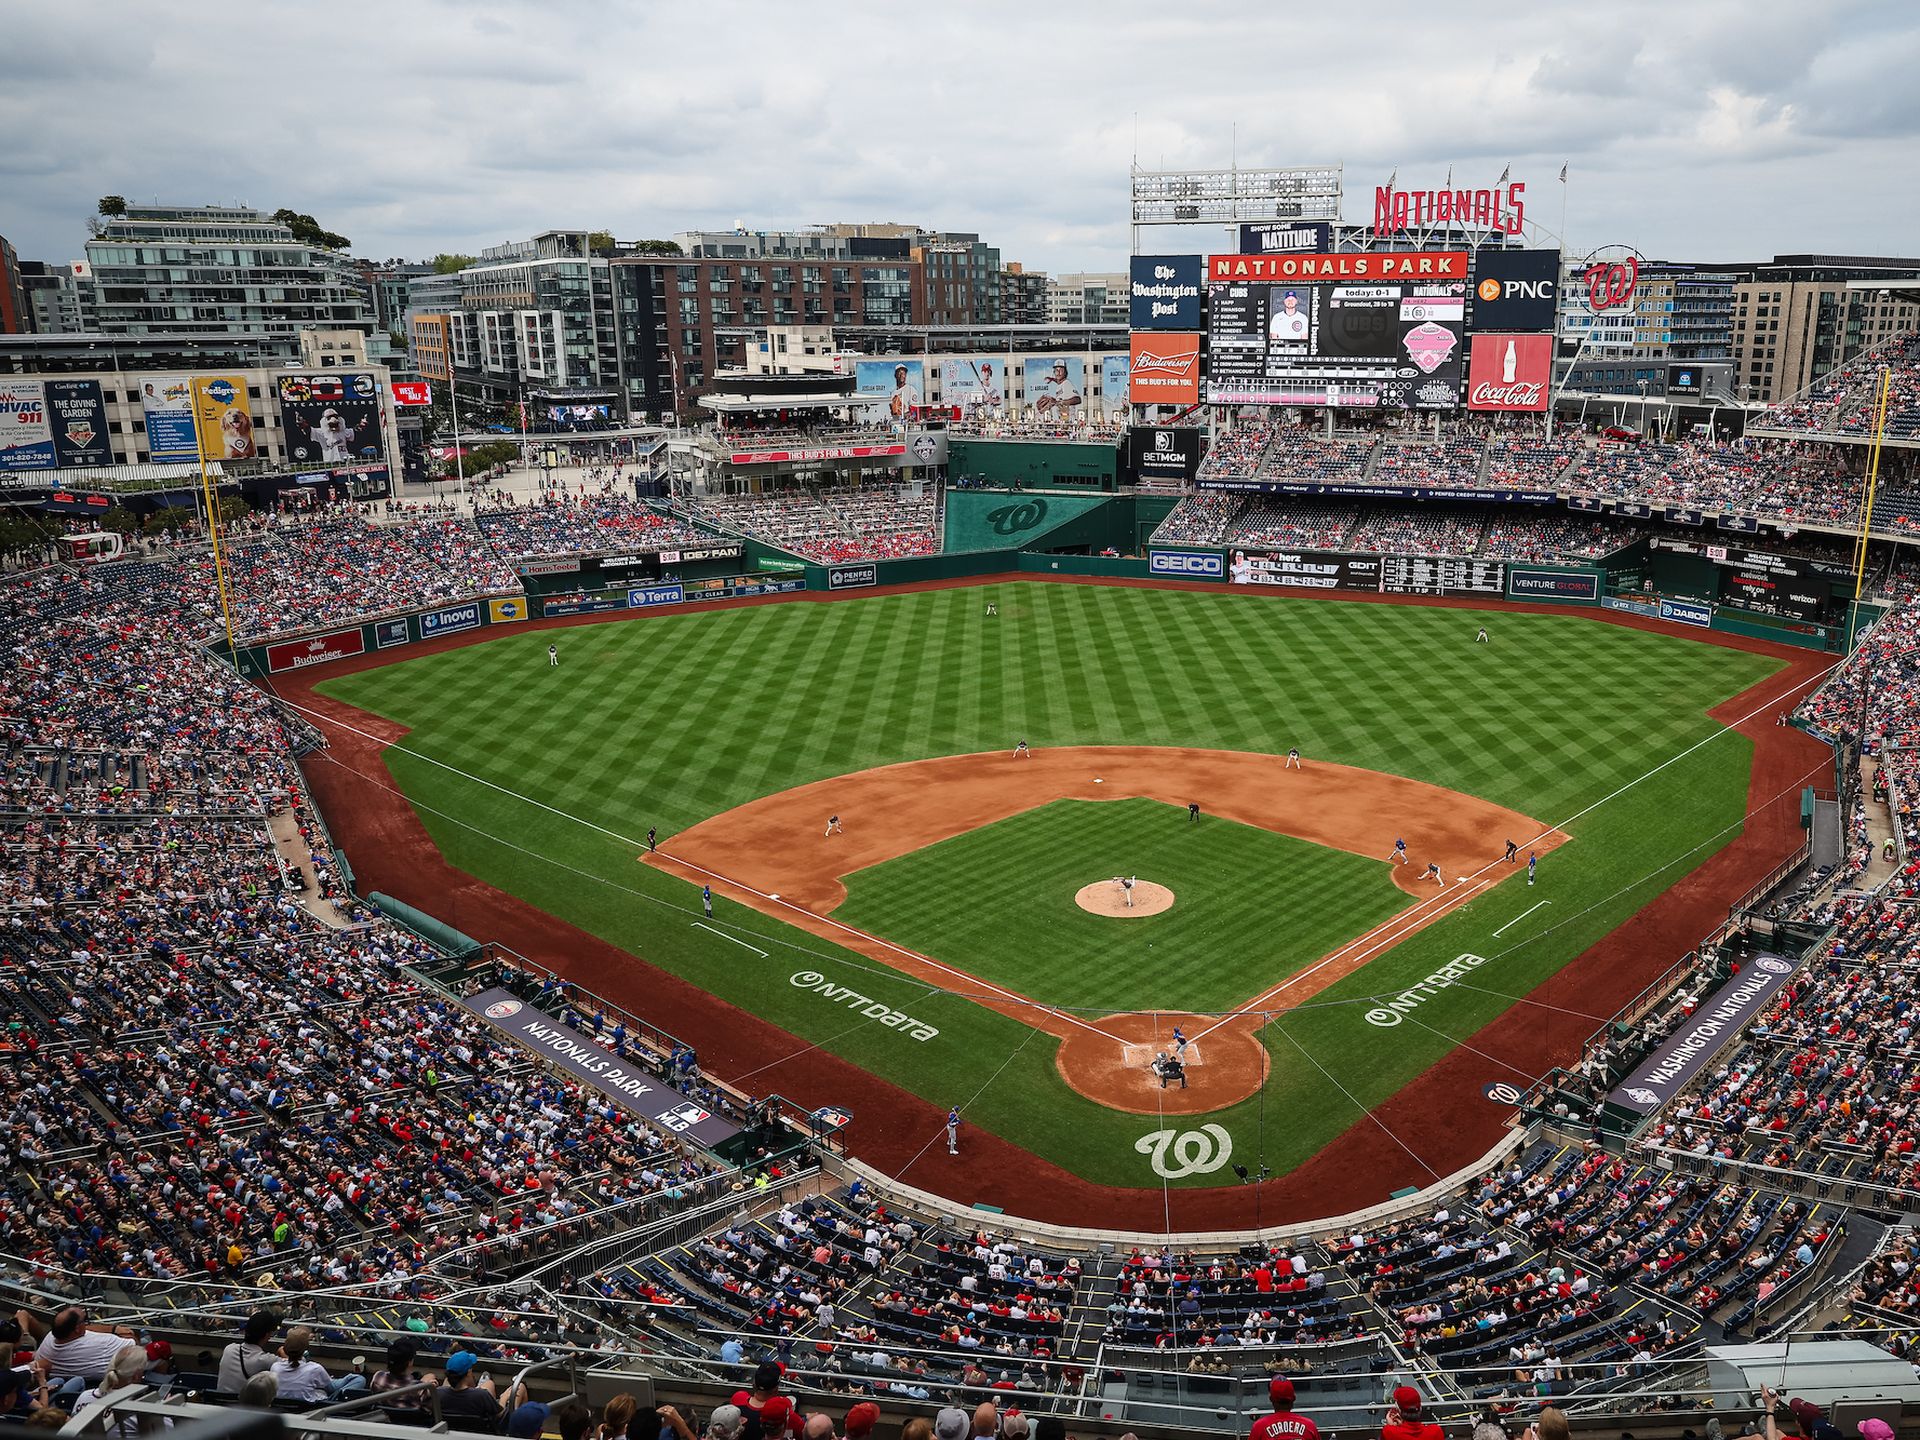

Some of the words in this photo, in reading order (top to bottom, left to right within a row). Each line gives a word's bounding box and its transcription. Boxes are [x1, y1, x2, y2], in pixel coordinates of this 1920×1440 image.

[1374, 182, 1526, 238] NATIONALS
[1250, 225, 1271, 233] SHOW
[1271, 223, 1292, 231] SOME
[1261, 228, 1318, 249] NATITUDE
[1154, 265, 1176, 280] The
[1216, 258, 1369, 276] NATIONALS
[1382, 257, 1454, 274] PARK
[1132, 281, 1198, 299] Washington
[1229, 287, 1248, 298] CUBS
[1413, 286, 1452, 296] NATIONALS
[1503, 280, 1554, 299] PNC
[1152, 302, 1178, 318] Post
[1312, 286, 1320, 324] michael
[1310, 326, 1320, 356] busch
[1136, 353, 1192, 368] Budweiser
[1135, 378, 1149, 386] THIS
[1150, 378, 1167, 386] BUD'S
[1167, 378, 1179, 386] FOR
[1180, 378, 1193, 386] YOU.
[201, 386, 240, 395] Pedigree
[408, 392, 422, 400] HALF
[0, 401, 42, 414] HVAC
[54, 400, 69, 409] THE
[70, 399, 97, 408] GIVING
[17, 412, 42, 424] 911
[62, 409, 92, 418] GARDEN
[787, 452, 803, 460] THIS
[804, 450, 824, 459] BUD'S
[826, 450, 839, 458] FOR
[840, 448, 855, 457] YOU.
[1143, 452, 1186, 462] BETMGM
[662, 552, 677, 561] 5:00
[711, 548, 738, 557] FAN
[1279, 552, 1302, 562] herz
[1709, 548, 1724, 558] 5:00
[1748, 553, 1773, 561] WELCOME
[1152, 554, 1220, 572] GEICO
[1348, 562, 1378, 570] GDIT
[1743, 557, 1772, 566] NATIONALS
[844, 570, 873, 579] PENFED
[1741, 572, 1768, 582] network
[1515, 579, 1556, 590] VENTURE
[1557, 581, 1592, 592] GLOBAL
[1742, 584, 1756, 593] rely
[646, 591, 679, 603] Terra
[1789, 594, 1817, 604] verizon
[440, 608, 475, 625] Inova
[1673, 608, 1709, 622] DABOS
[292, 648, 342, 666] Budweiser
[812, 982, 875, 1009] NTT
[1388, 982, 1438, 1013] NTT
[1644, 1018, 1726, 1086] WASHINGTON
[1711, 971, 1774, 1022] NATIONALS
[522, 1020, 611, 1075] NATIONALS
[600, 1066, 654, 1100] PARK
[654, 1111, 690, 1132] MLB
[1266, 1420, 1306, 1438] CORDERO
